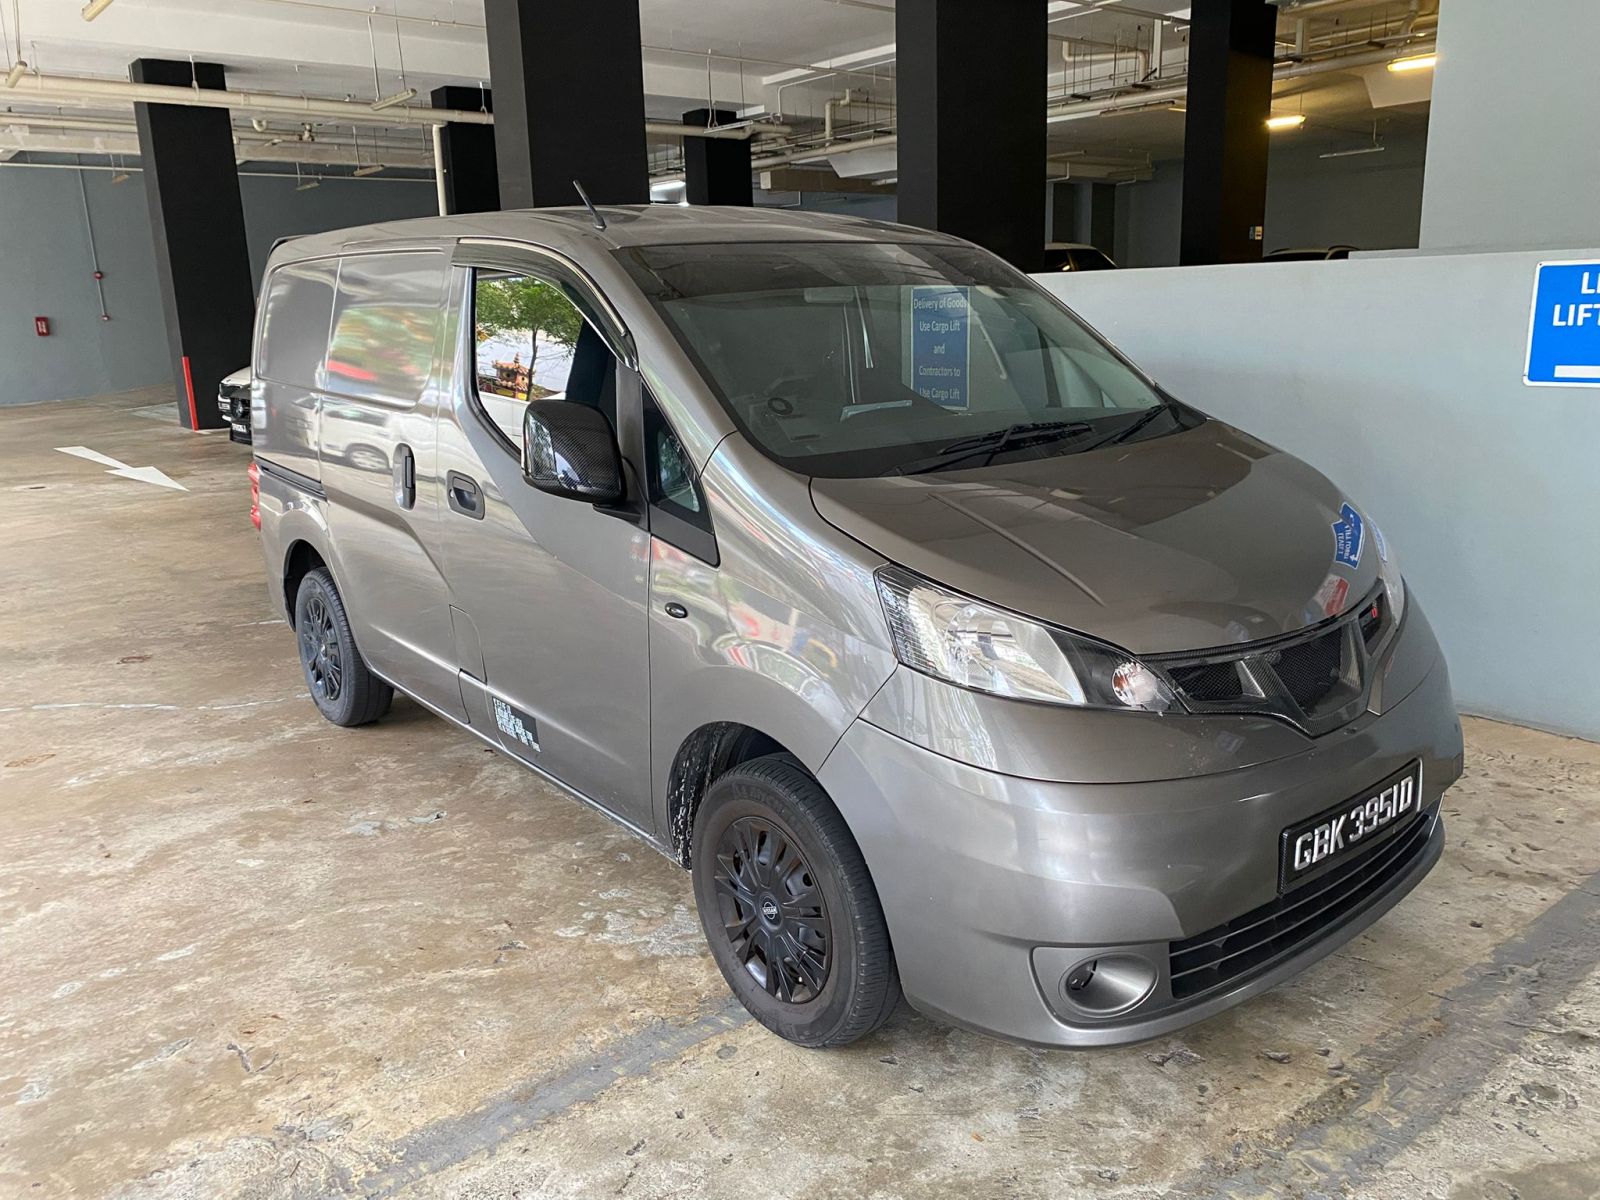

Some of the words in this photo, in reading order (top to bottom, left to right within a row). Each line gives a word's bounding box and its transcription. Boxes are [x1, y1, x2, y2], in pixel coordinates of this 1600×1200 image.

[1581, 272, 1600, 294] L
[913, 298, 938, 311] Delivery
[939, 297, 946, 309] of
[946, 296, 967, 308] Goods
[919, 320, 930, 332] Use
[931, 320, 949, 334] Cargo
[949, 319, 960, 332] Lift
[933, 343, 945, 354] and
[919, 365, 953, 377] Contractors
[953, 367, 960, 377] to
[919, 387, 930, 399] Use
[931, 387, 949, 401] Cargo
[949, 387, 960, 400] Lift
[1294, 813, 1347, 871] GBK
[1349, 775, 1413, 842] 3951D
